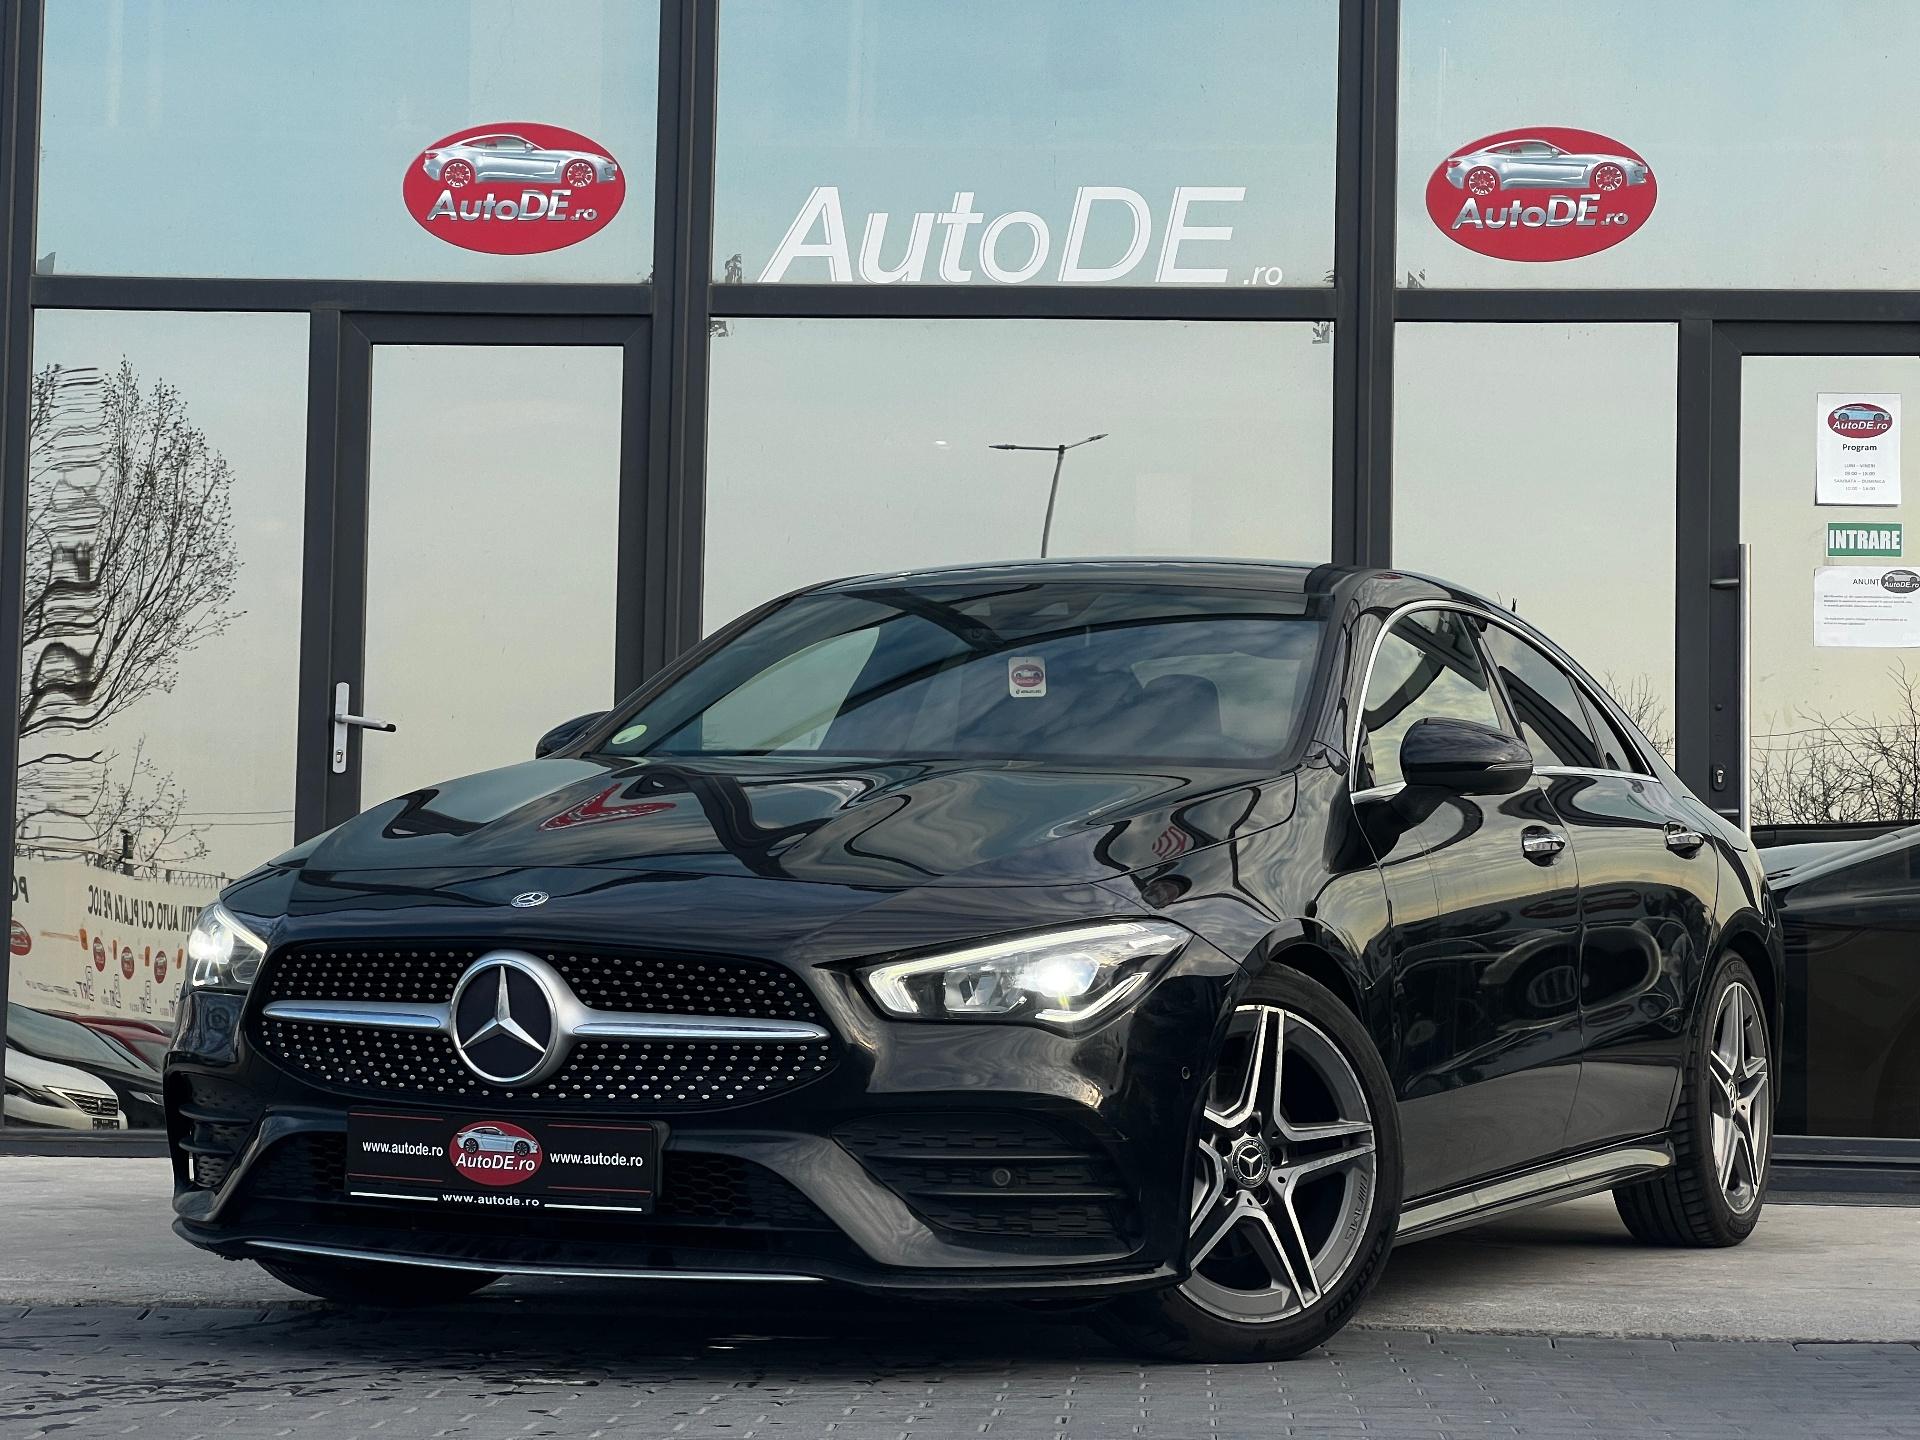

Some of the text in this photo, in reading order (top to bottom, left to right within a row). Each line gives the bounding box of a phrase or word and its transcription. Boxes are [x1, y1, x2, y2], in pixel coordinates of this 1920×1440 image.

[1832, 420, 1888, 430] AutoDE.ro
[1842, 443, 1878, 452] Program
[1829, 529, 1901, 550] INTRARE
[362, 1139, 444, 1157] www.autode.ro
[455, 1152, 536, 1171] AutoDE.ro
[549, 1152, 644, 1168] www.autode.ro
[442, 1193, 540, 1207] www.autode.ro
